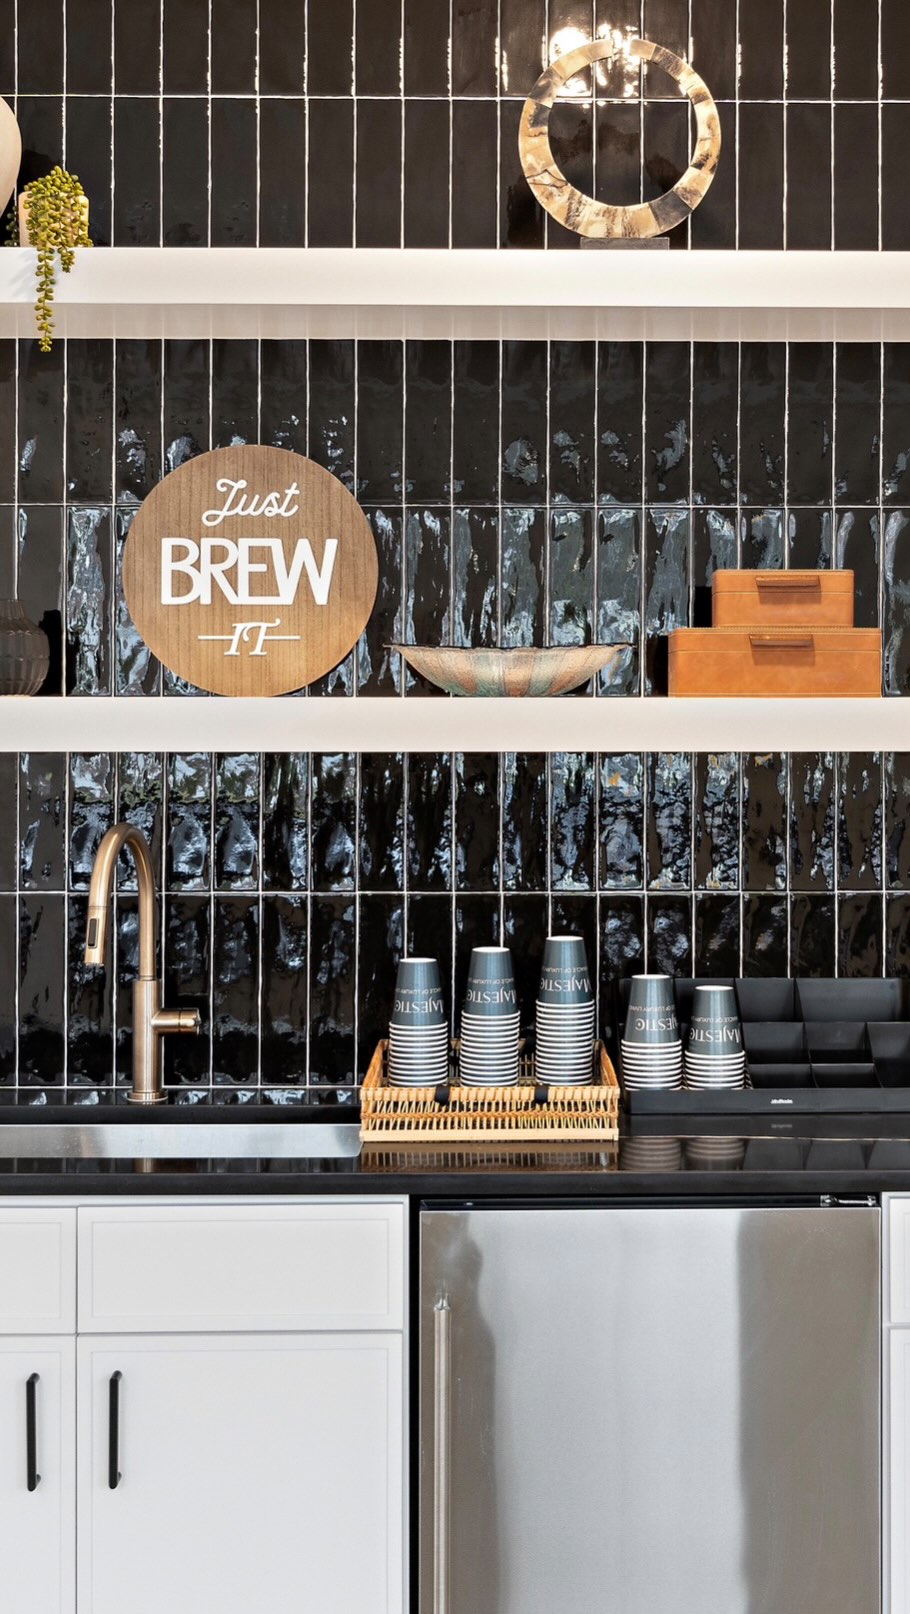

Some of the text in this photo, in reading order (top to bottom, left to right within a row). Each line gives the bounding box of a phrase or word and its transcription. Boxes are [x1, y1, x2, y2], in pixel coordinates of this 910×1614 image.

[202, 478, 300, 527] Just
[161, 537, 338, 605] BREW
[224, 618, 281, 656] IT
[635, 1013, 678, 1031] JESTIC
